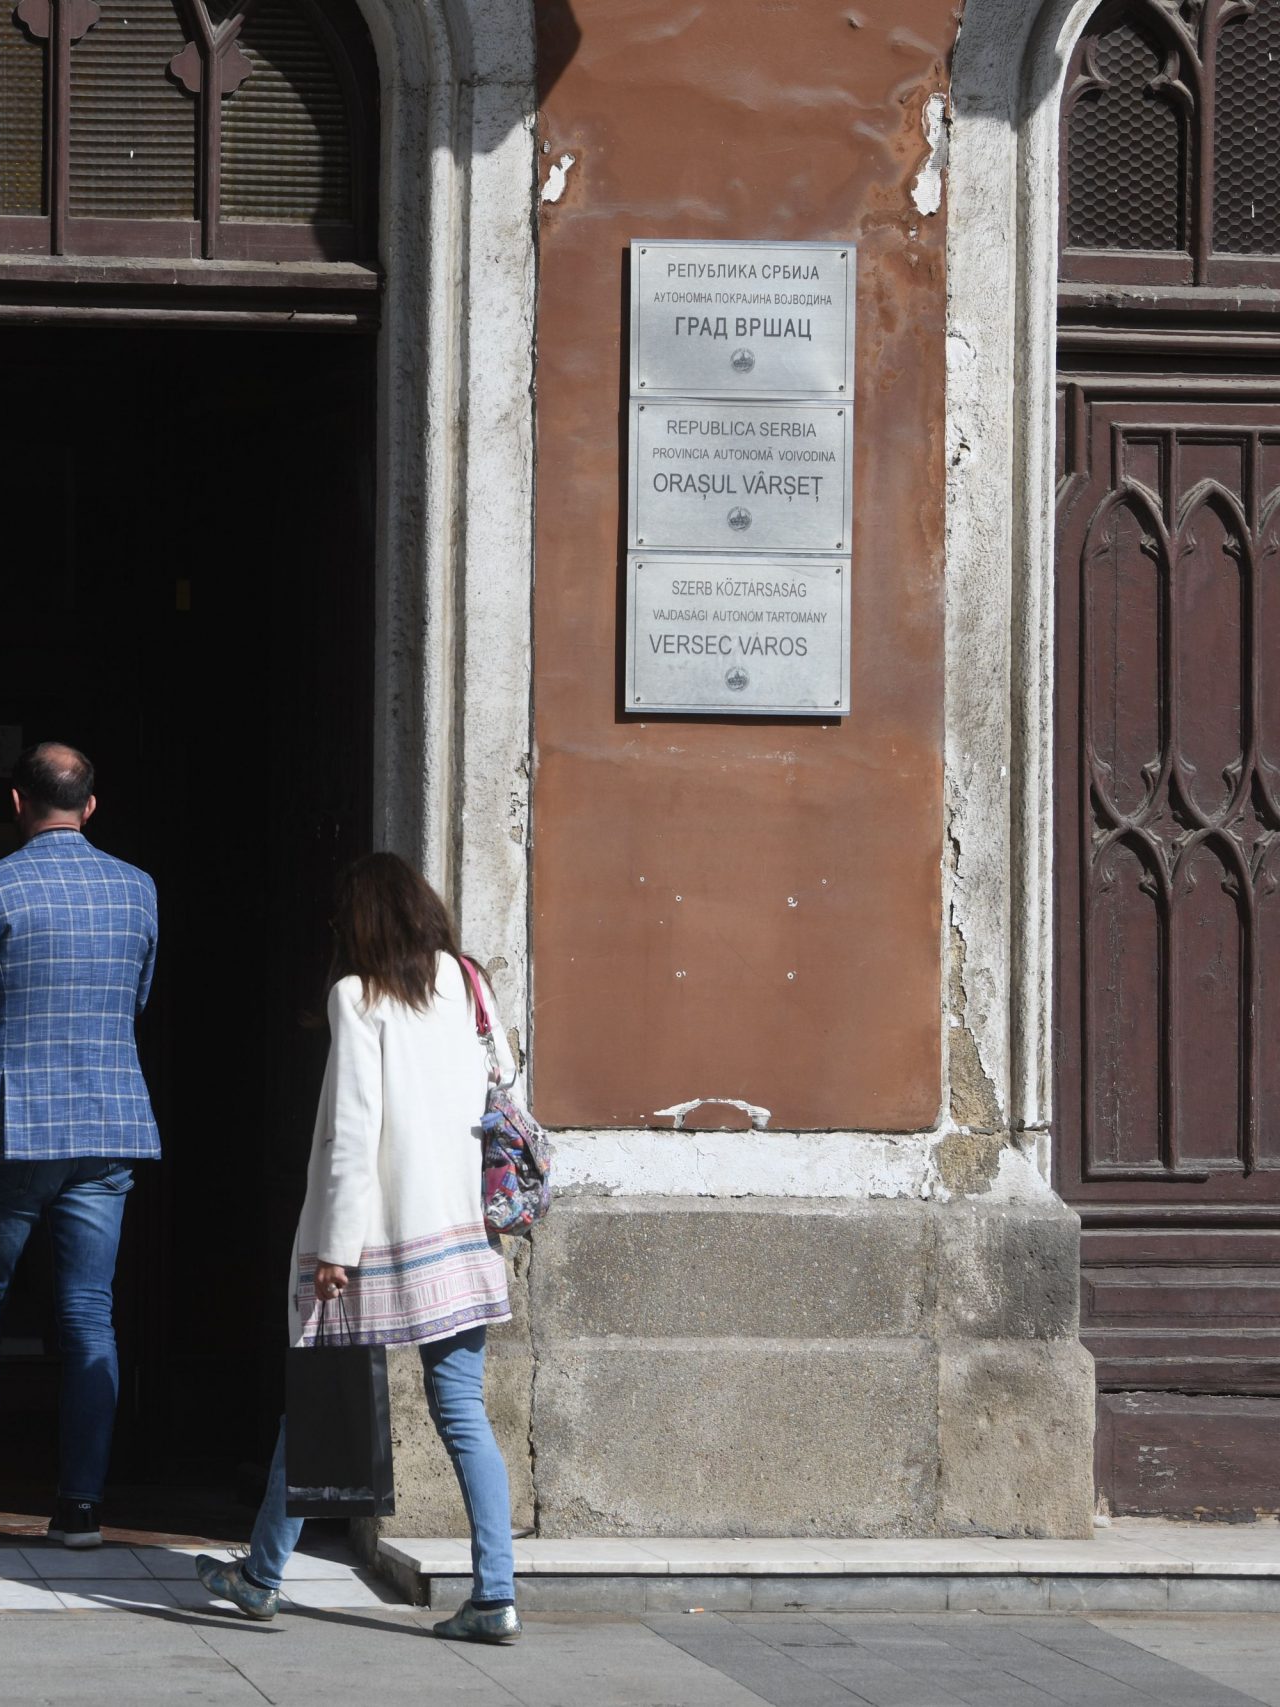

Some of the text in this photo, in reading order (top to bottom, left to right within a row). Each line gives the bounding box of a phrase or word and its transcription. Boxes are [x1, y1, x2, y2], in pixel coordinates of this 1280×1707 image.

[667, 263, 819, 280] РЕПУБЛИКА СРБИЈА
[654, 291, 832, 306] АУТОНОМНА ПОКРАЈИНА ВОЈВОДИНА
[675, 317, 812, 341] ГРАД ВРШАЦ
[667, 420, 817, 437] REPUBLICA SERBIA
[652, 446, 836, 462] PROVINCIA AUTONOMĂ VOIVODINA
[653, 471, 823, 502] ORAȘUL VÂRȘEȚ
[672, 578, 807, 597] SZERB KÖZTÁRSASÁG
[652, 607, 828, 623] VAJDASÁGI AUTONÓM TARTOMÁNY
[649, 632, 808, 657] VERSEC VÁROS
